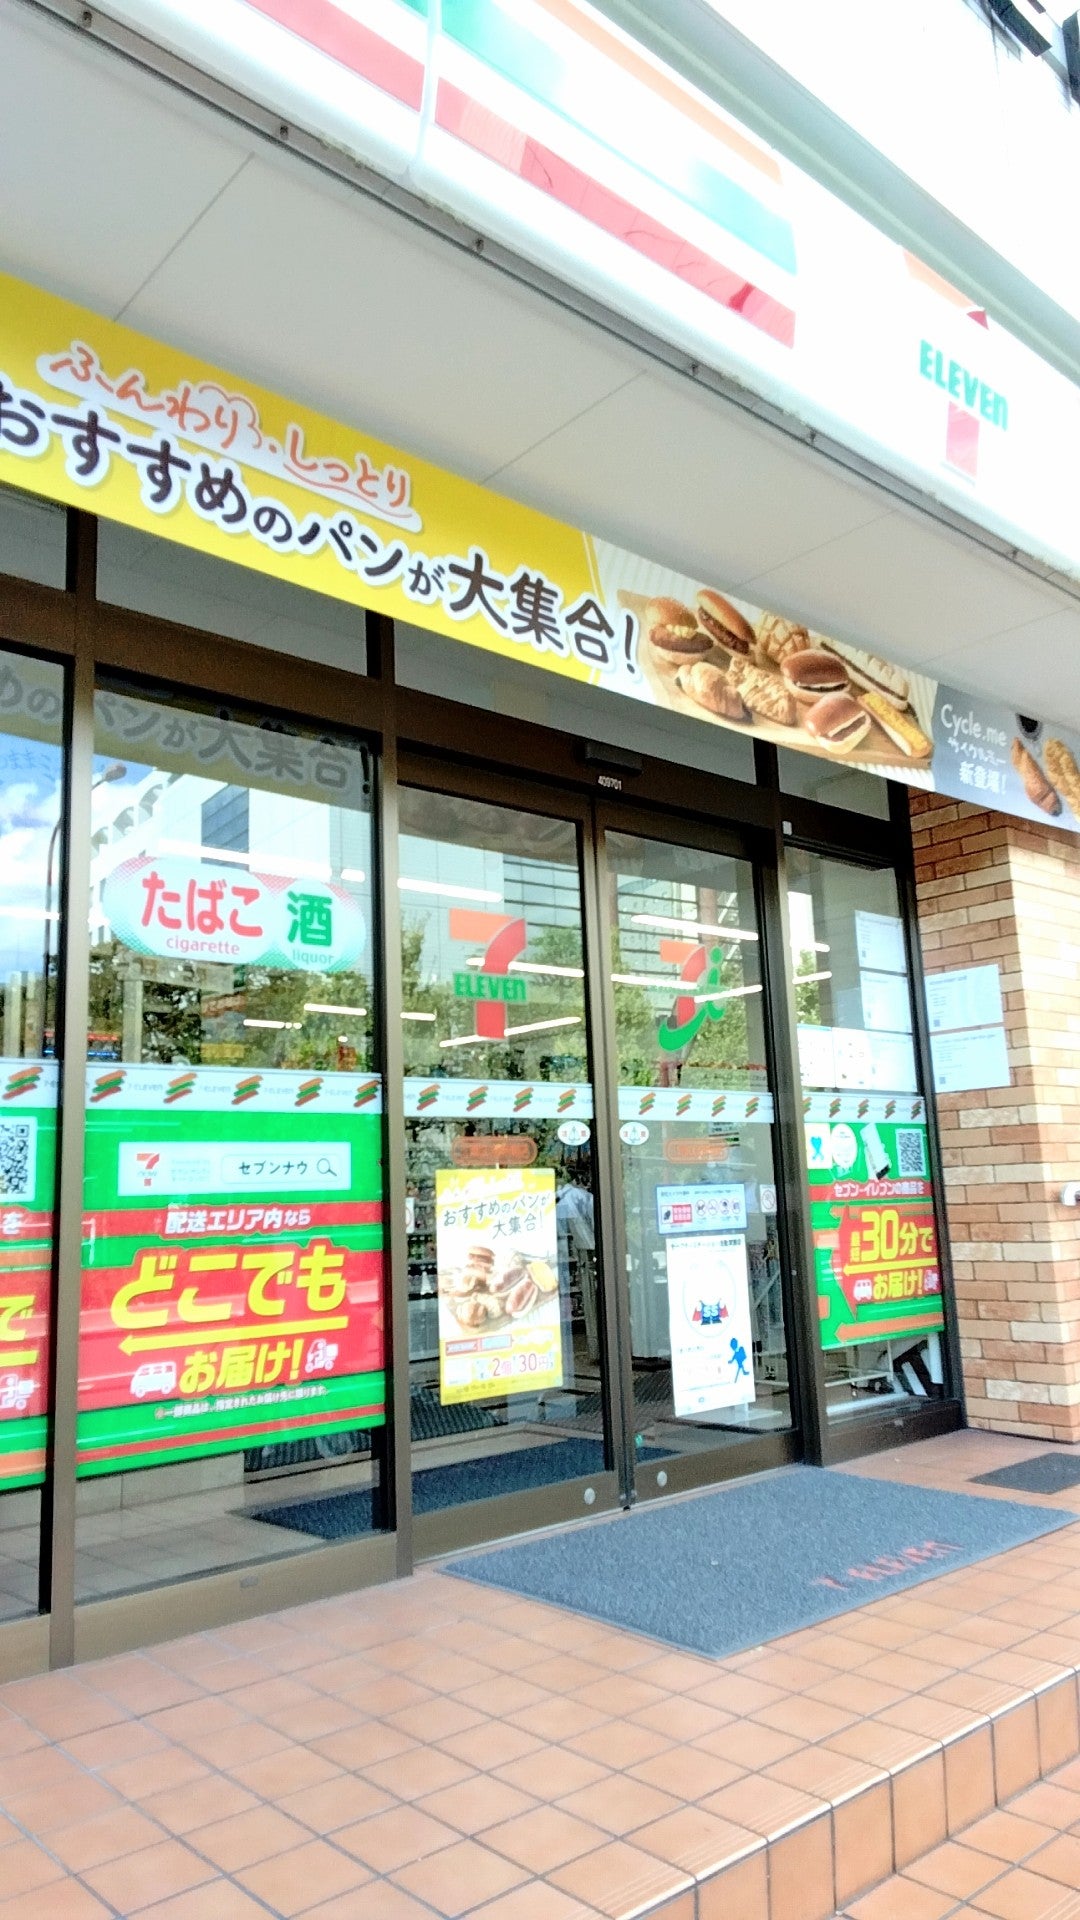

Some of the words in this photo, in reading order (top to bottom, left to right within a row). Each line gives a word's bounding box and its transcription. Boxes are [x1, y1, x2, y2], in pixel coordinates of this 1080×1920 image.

[940, 703, 1007, 747] Cycle.me
[142, 871, 263, 937] たばこ
[287, 890, 332, 947] 酒
[166, 936, 240, 956] cigarette
[292, 949, 335, 966] liquor
[239, 1160, 307, 1176] セブンナウ
[165, 1207, 311, 1234] 配送エリア内なら
[110, 1245, 347, 1329] どこでも
[873, 1270, 923, 1299] お届け!
[179, 1338, 304, 1394] お届け!
